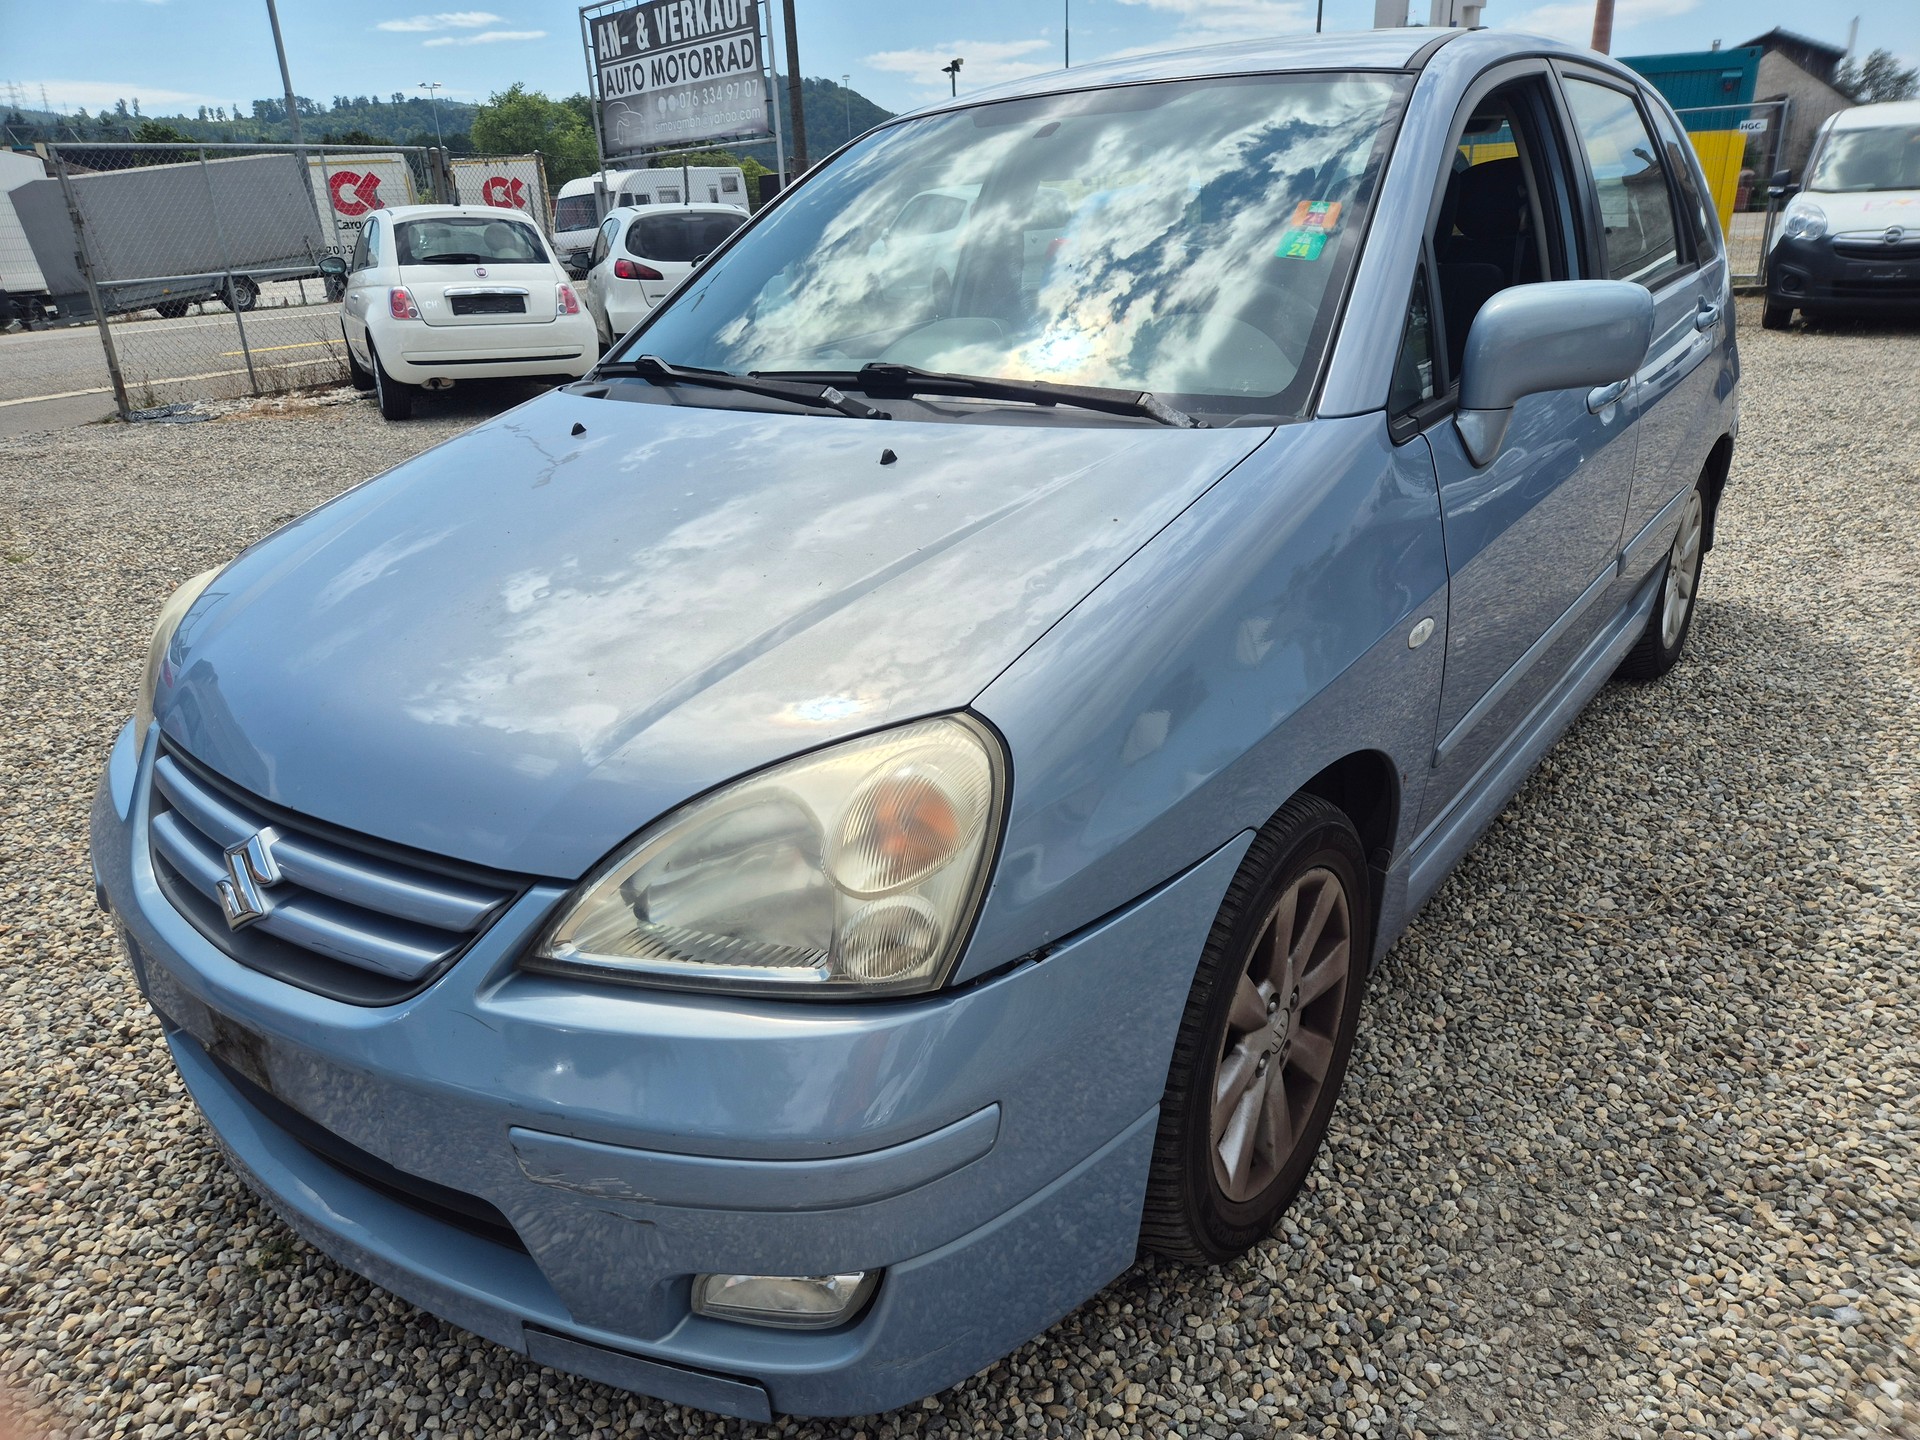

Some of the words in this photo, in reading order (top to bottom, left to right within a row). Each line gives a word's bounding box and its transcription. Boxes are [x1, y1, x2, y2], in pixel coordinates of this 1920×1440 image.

[598, 20, 629, 60] AN-
[636, 12, 650, 50] &
[654, 0, 751, 44] VERKAUF
[606, 63, 645, 97] AUTO
[651, 38, 754, 88] MOTORRAD
[679, 90, 699, 110] 076
[703, 86, 723, 105] 334
[727, 83, 743, 99] 97
[745, 79, 758, 96] 07
[655, 108, 761, 135] simovgmbh@yahoo.com
[1740, 121, 1762, 130] HGC
[337, 219, 363, 232] Carg
